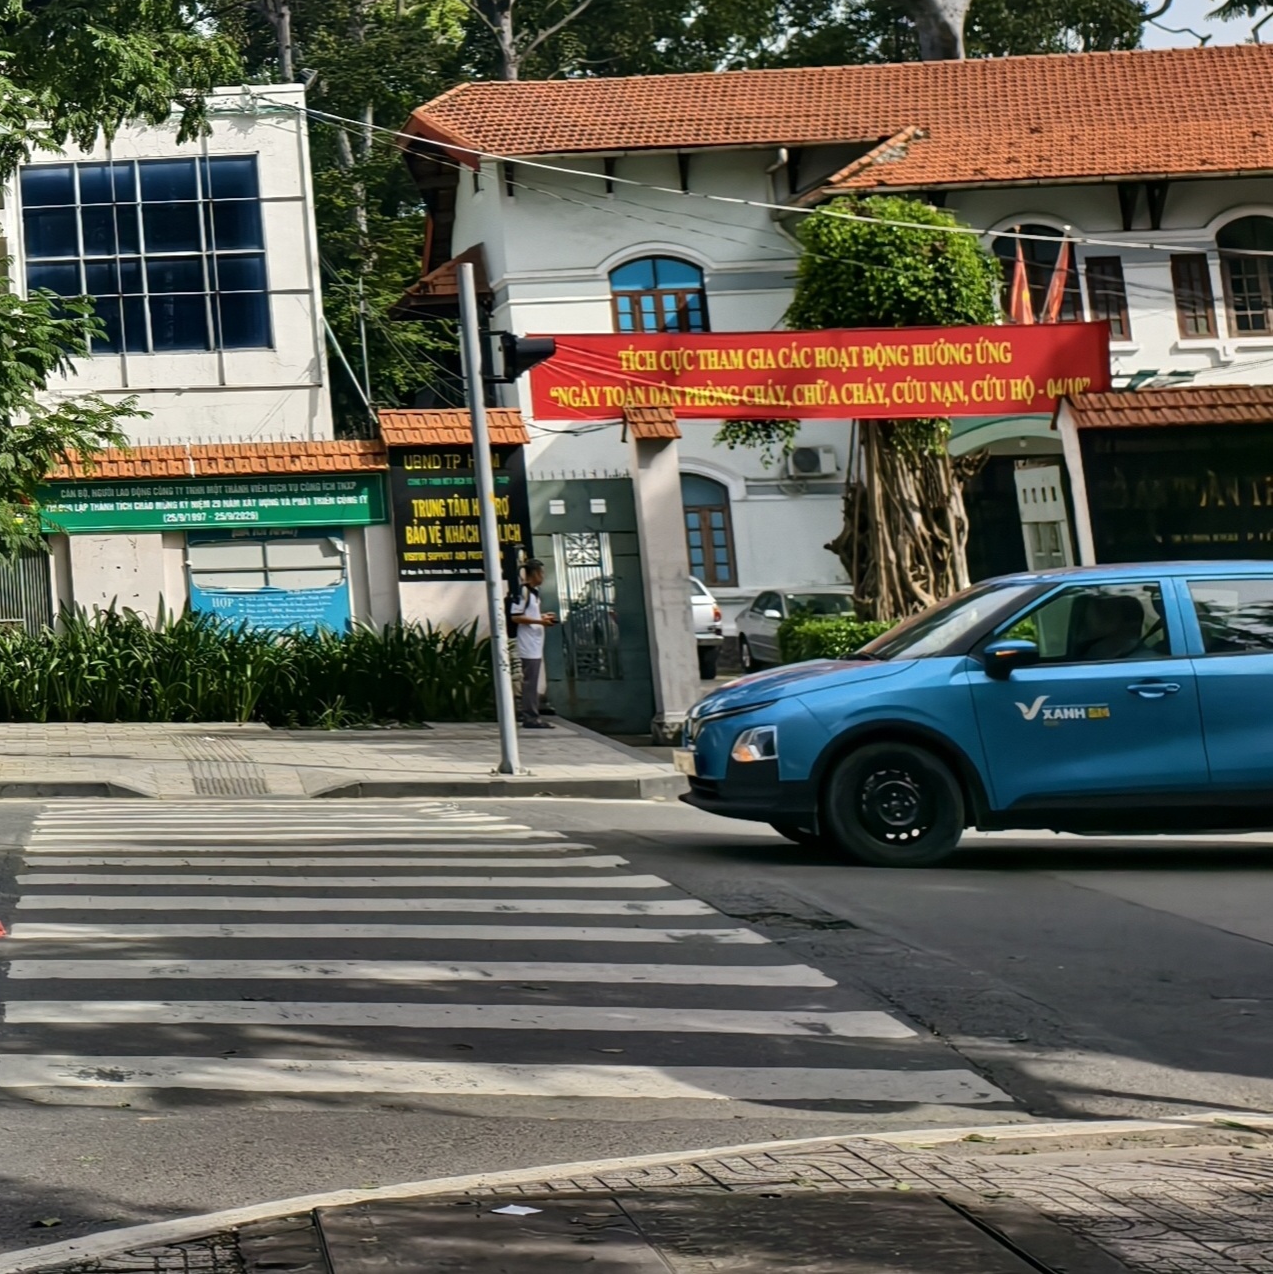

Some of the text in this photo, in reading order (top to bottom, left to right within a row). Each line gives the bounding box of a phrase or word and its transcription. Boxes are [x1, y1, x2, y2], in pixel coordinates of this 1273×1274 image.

[618, 336, 1012, 375] TÍCH CỰC THAM GIA CÁC HOẠT ĐỘNG HƯỞNG ỨNG
[603, 381, 647, 407] TOÀN
[649, 380, 682, 406] DÂN
[684, 380, 740, 407] PHÒNG
[743, 379, 791, 409] CHÁY,
[792, 378, 840, 407] CHỮA
[841, 377, 890, 407] CHÁY,
[892, 376, 928, 403] CỨU
[930, 380, 969, 407] NẠN,
[971, 374, 1007, 401] CỨU
[1010, 375, 1035, 405] HỘ
[403, 454, 442, 470] UBND
[443, 454, 462, 469] TP
[116, 488, 130, 497] LAO
[153, 485, 174, 496] CÔNG
[175, 486, 184, 495] TY
[412, 498, 446, 517] TRUNG
[447, 493, 470, 516] TÂM
[405, 519, 427, 544] BẢO
[428, 521, 442, 547] VỆ
[444, 520, 480, 543] KHÁCH
[1042, 708, 1086, 719] XANH
